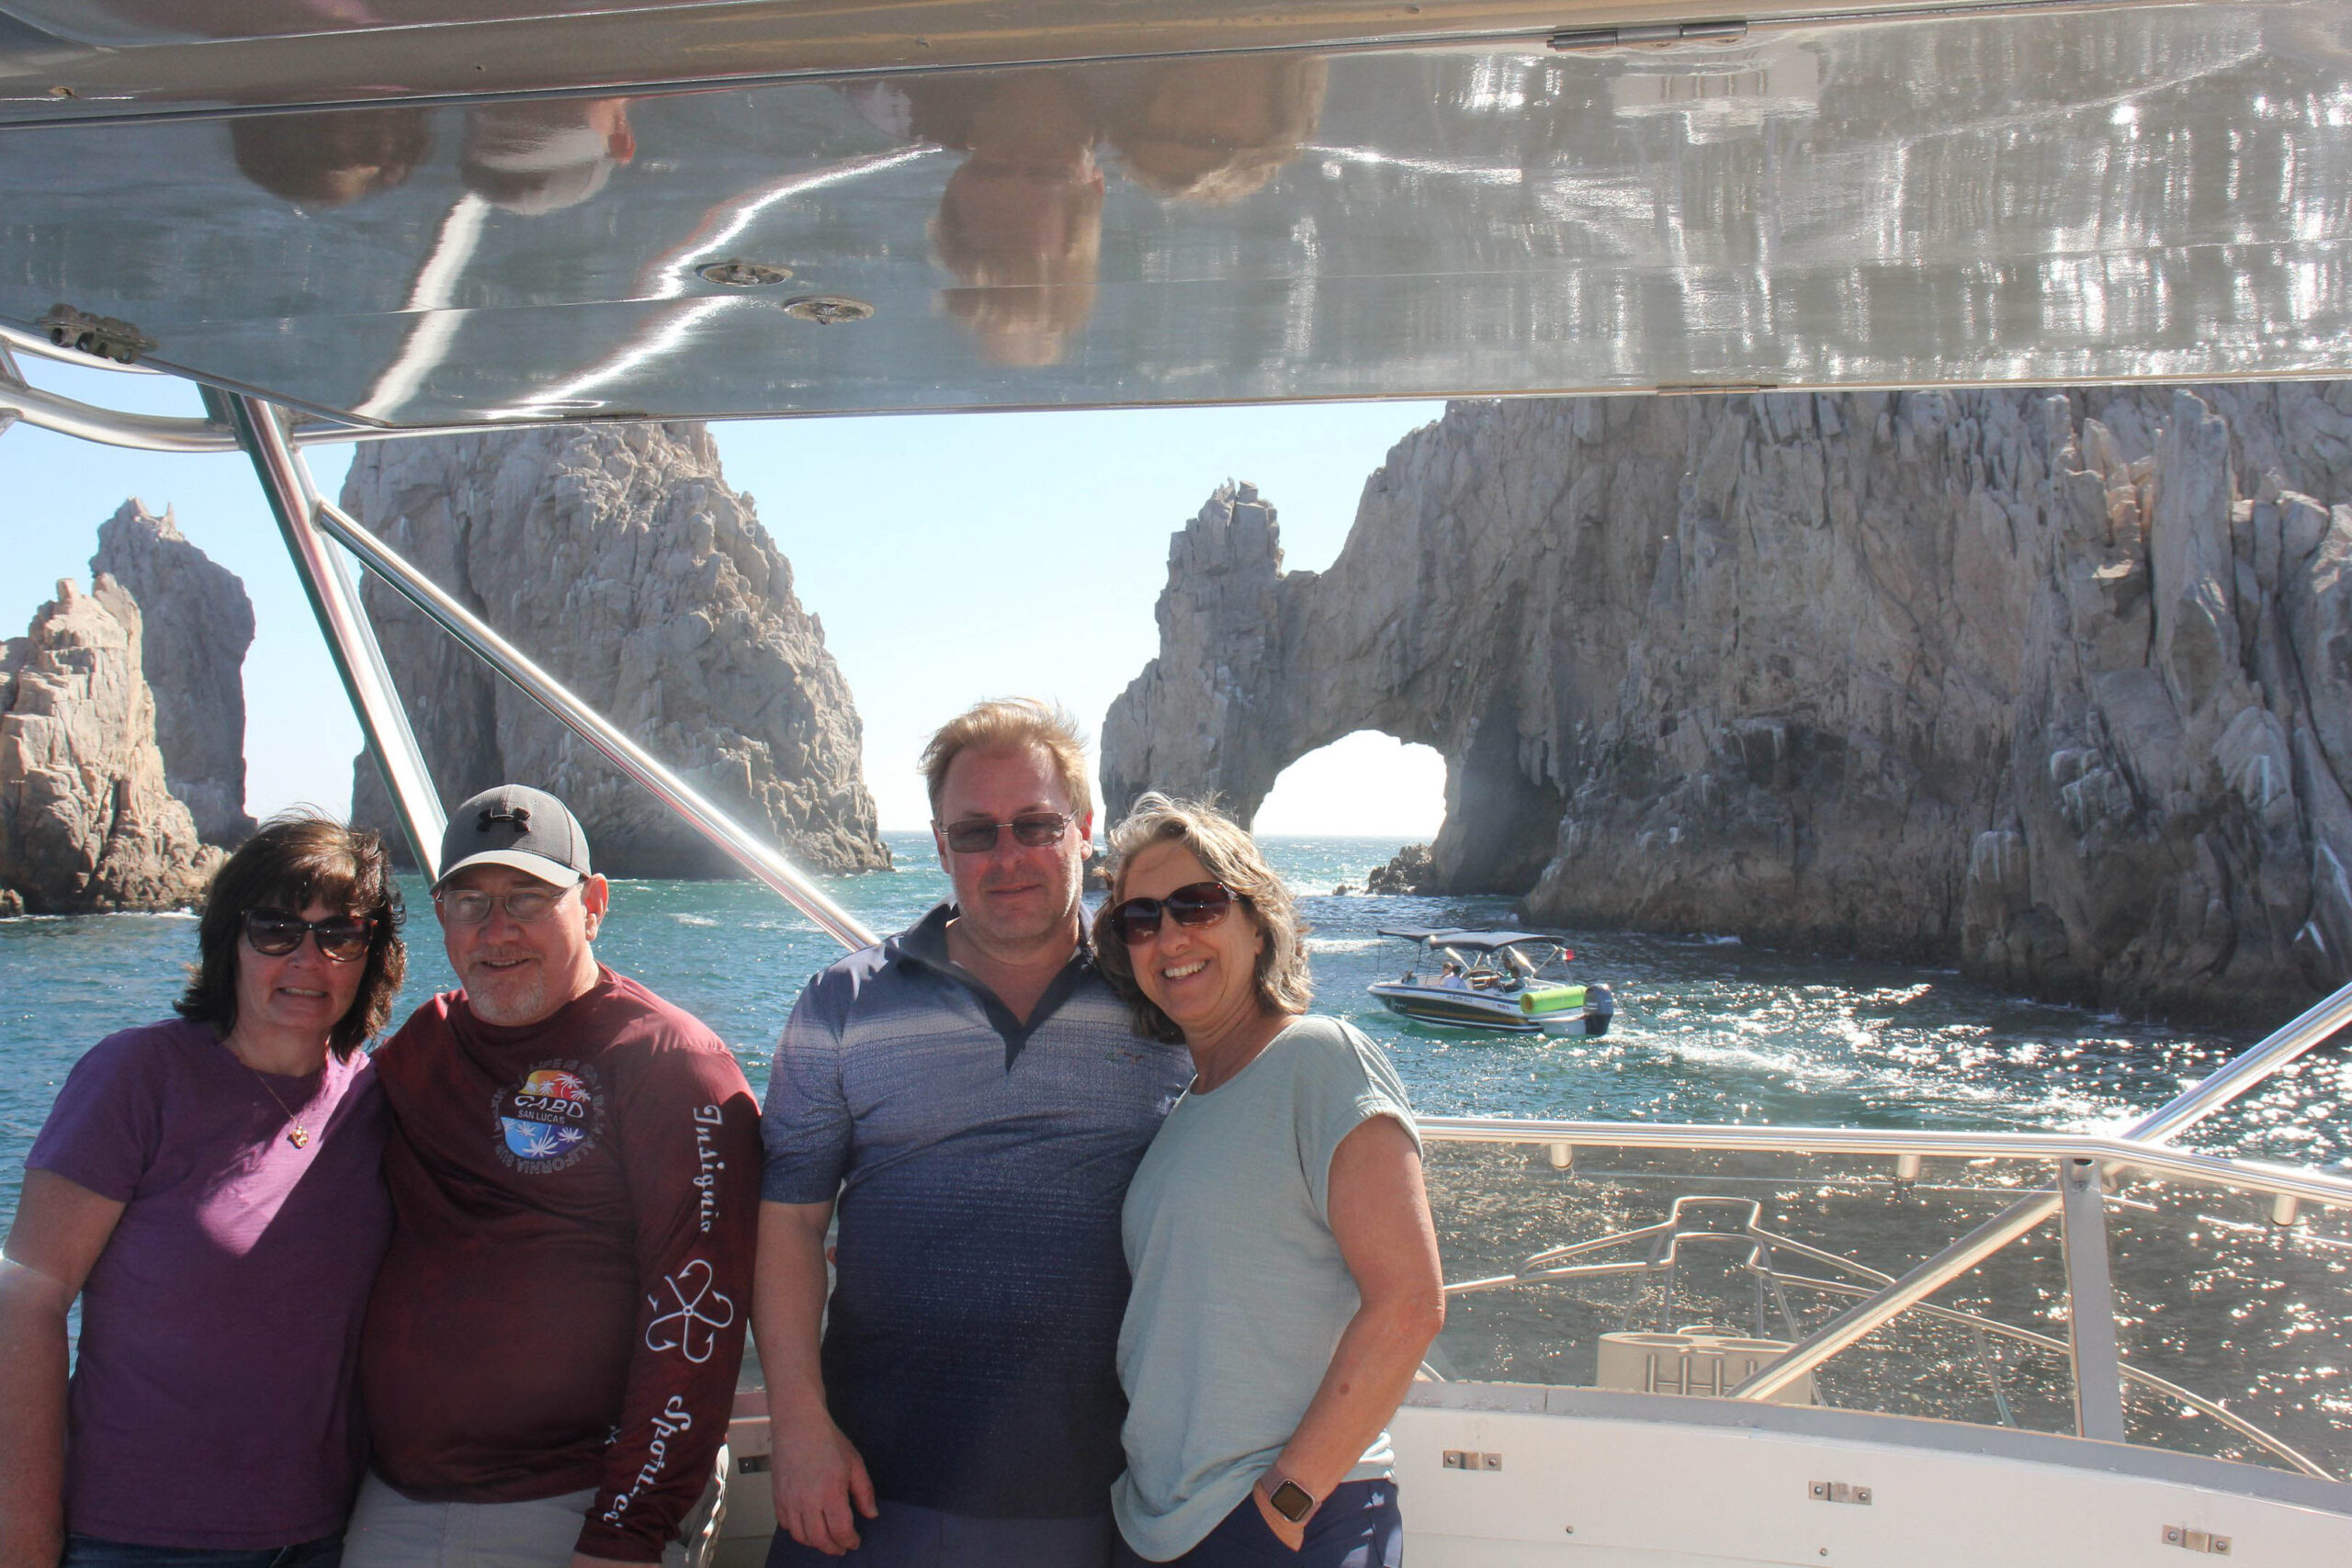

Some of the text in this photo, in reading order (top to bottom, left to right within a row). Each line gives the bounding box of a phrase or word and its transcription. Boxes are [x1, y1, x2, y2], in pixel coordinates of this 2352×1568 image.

[514, 1095, 584, 1118] CABO
[517, 1109, 565, 1124] SAN LUCAS
[693, 1104, 725, 1233] Insignia
